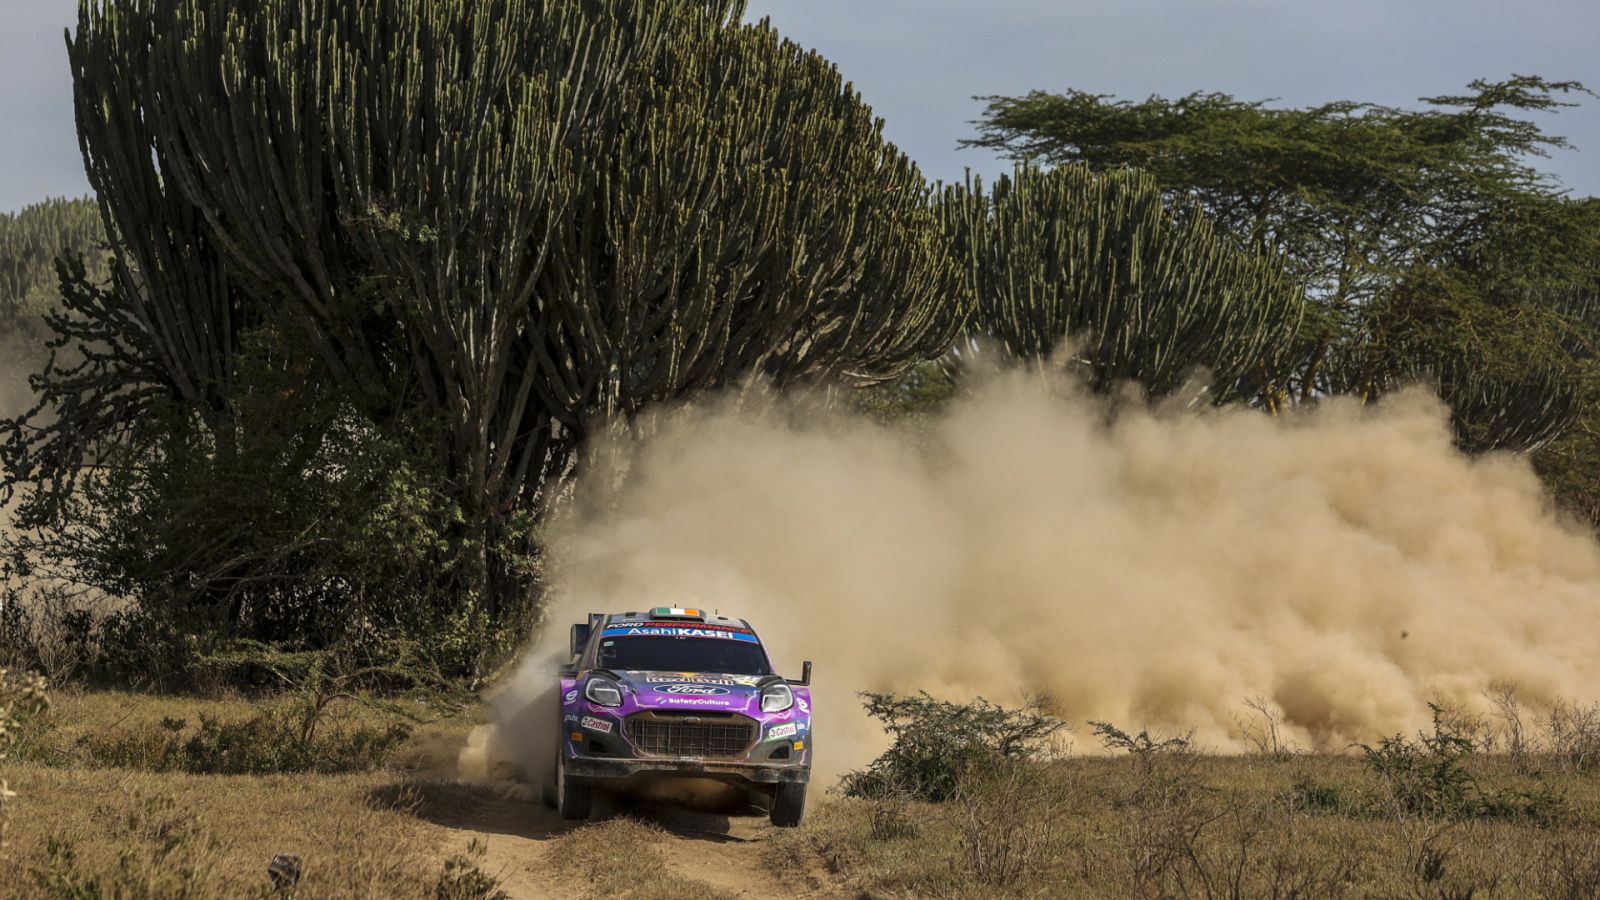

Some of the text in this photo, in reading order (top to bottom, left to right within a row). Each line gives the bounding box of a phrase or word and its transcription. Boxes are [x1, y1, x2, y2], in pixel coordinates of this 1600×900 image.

[645, 622, 749, 633] PERFORMANCE
[667, 685, 717, 694] Ford
[668, 698, 730, 706] SafetyCulture
